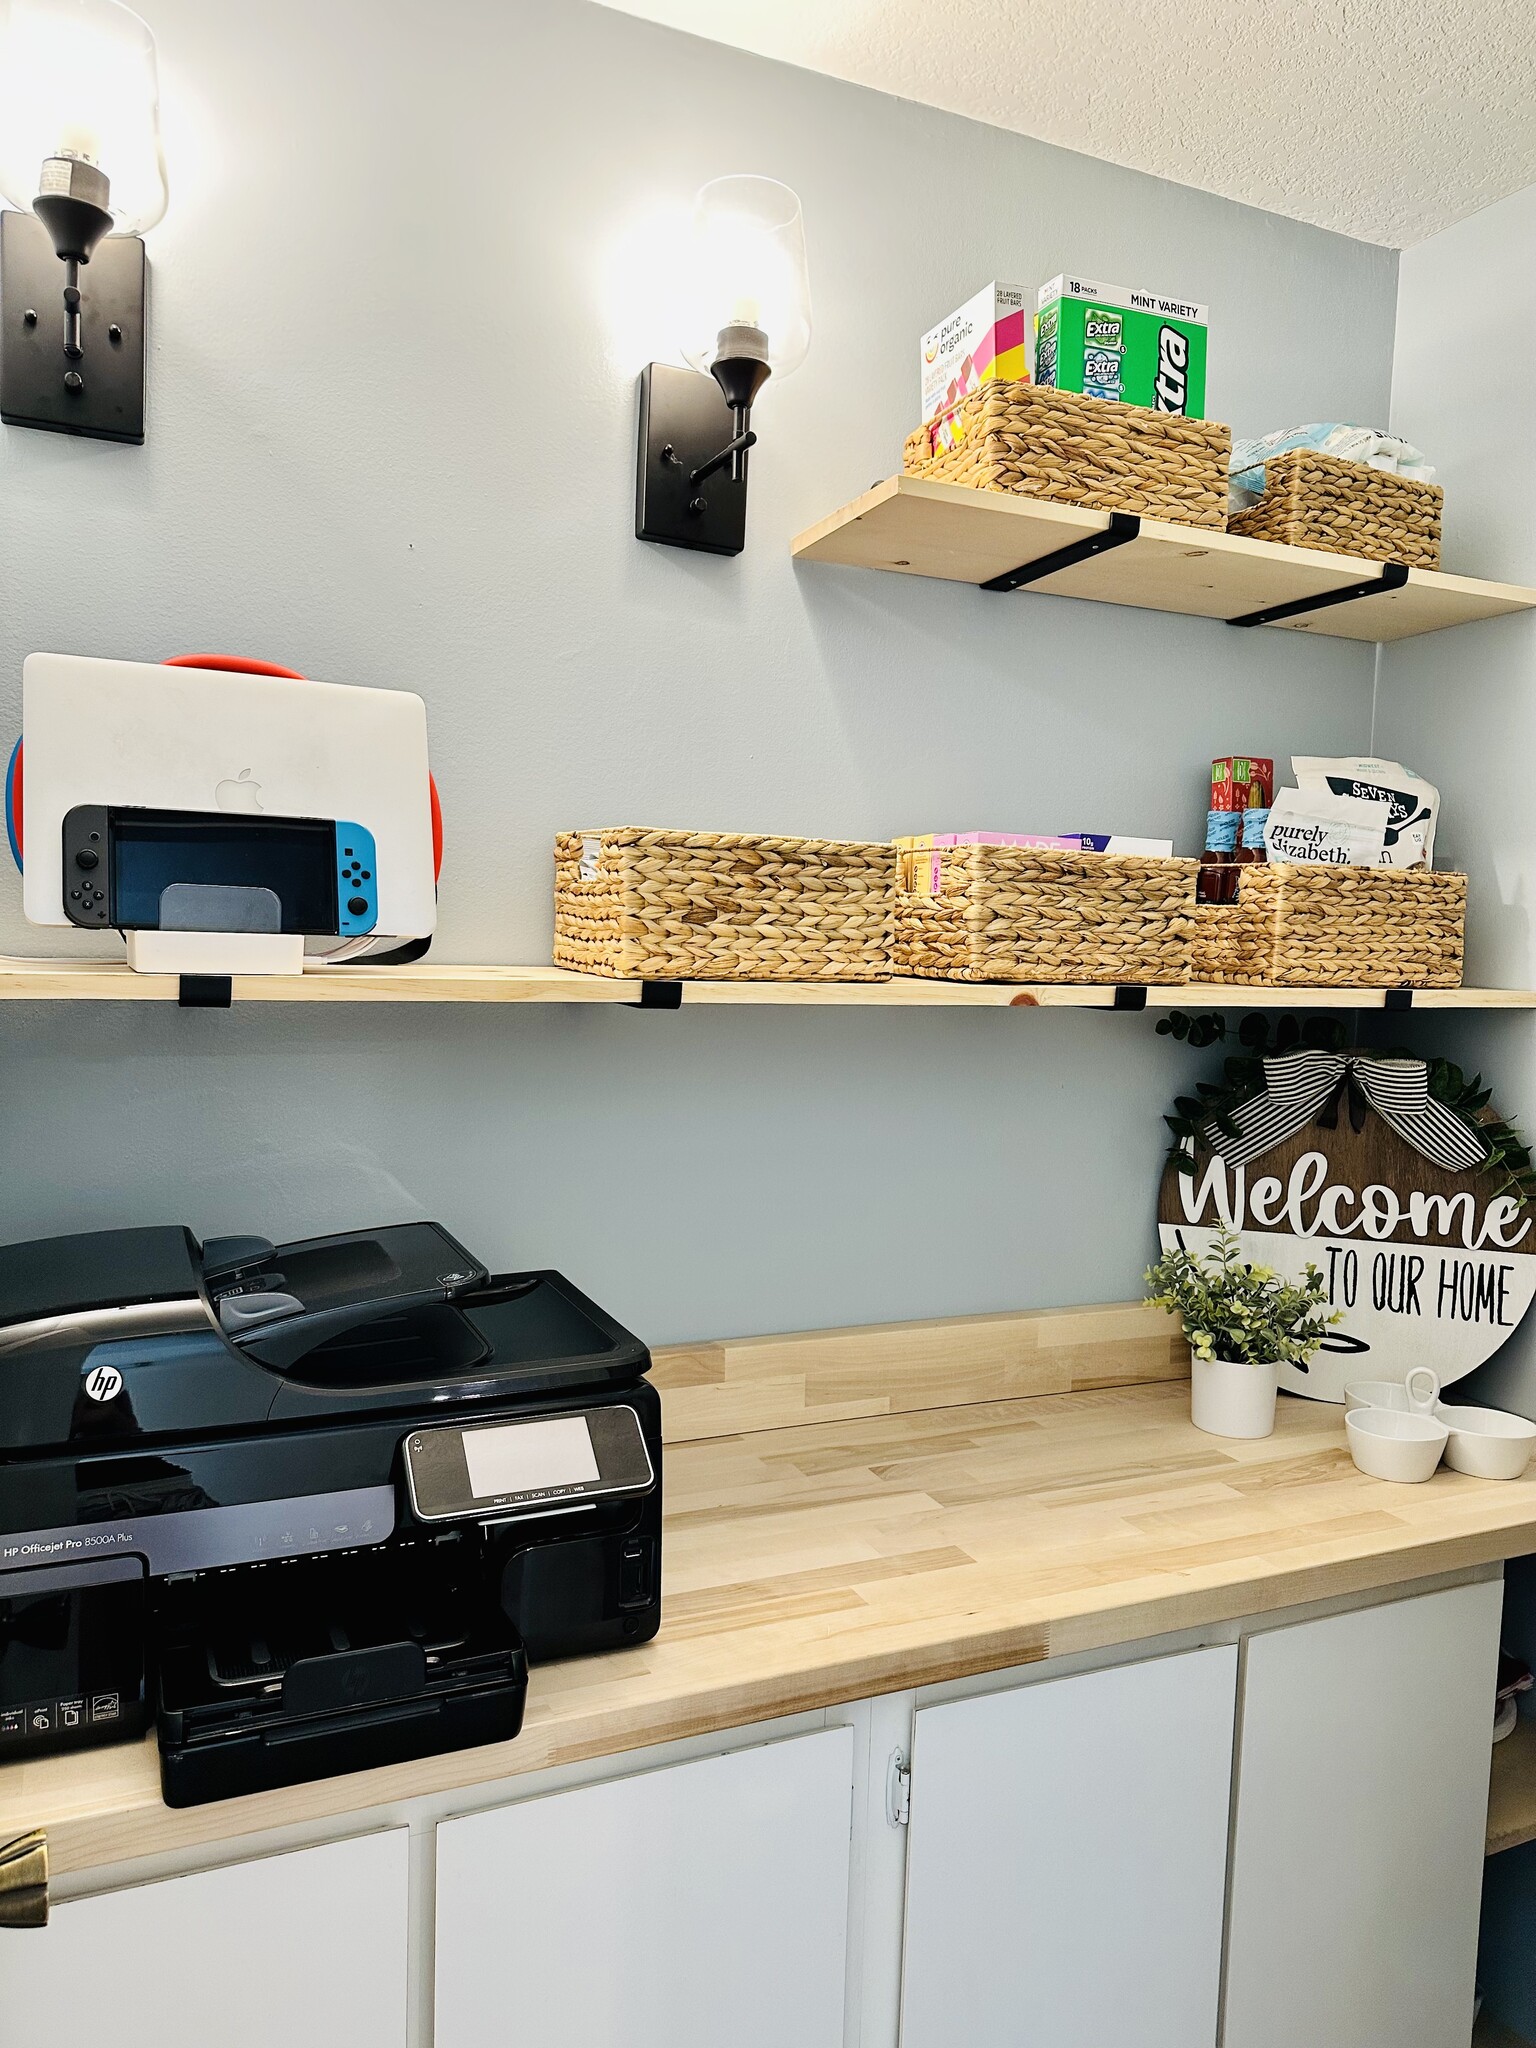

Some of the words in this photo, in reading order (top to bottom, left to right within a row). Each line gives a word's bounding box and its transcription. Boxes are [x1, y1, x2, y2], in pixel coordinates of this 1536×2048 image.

[1003, 290, 1023, 300] LAYERED
[1069, 281, 1081, 293] 18
[1081, 286, 1098, 294] PACKS
[996, 298, 1010, 306] FRUIT
[1010, 299, 1022, 307] BARS
[1131, 294, 1156, 309] MINT
[1158, 300, 1198, 318] VARIETY
[940, 321, 973, 354] organic
[941, 315, 962, 342] pure
[1086, 321, 1120, 338] Extra
[1085, 359, 1119, 376] Extra
[1352, 782, 1396, 803] SEVEN
[1269, 825, 1329, 847] purely
[1178, 1135, 1532, 1251] Welcome
[1325, 1246, 1358, 1308] TO
[1372, 1252, 1425, 1316] OUR
[1437, 1258, 1515, 1327] HOME
[91, 1368, 118, 1400] hp
[4, 1548, 19, 1557] HP
[21, 1543, 64, 1554] Officejet
[65, 1539, 83, 1549] Pro
[84, 1535, 116, 1547] 8500A
[117, 1533, 133, 1543] Plus
